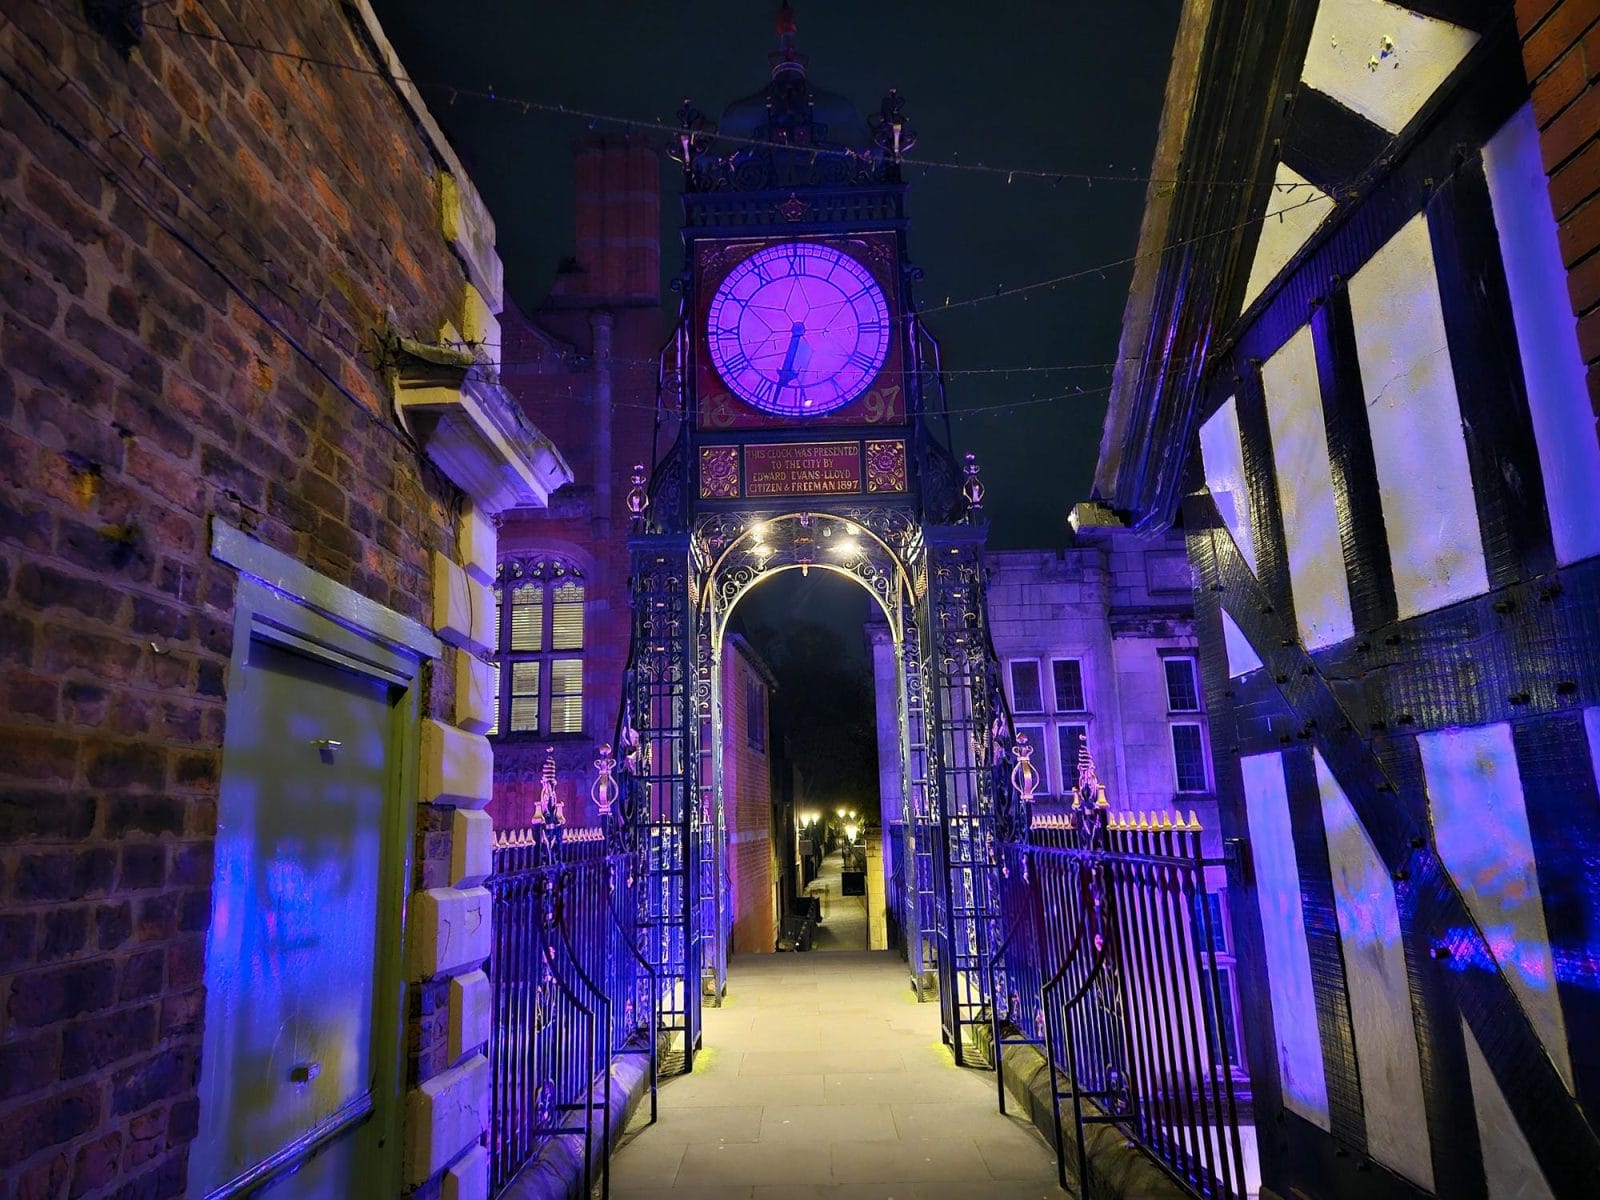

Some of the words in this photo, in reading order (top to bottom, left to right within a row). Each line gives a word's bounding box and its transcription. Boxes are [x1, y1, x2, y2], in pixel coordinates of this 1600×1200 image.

[864, 385, 901, 423] 97
[746, 449, 766, 460] THIS
[767, 448, 793, 459] CLOCK
[794, 447, 813, 458] WAS
[814, 446, 858, 457] PRESENTED
[771, 460, 782, 470] TO
[785, 459, 801, 470] THE
[802, 459, 821, 469] CITY
[823, 458, 834, 468] BY
[752, 472, 786, 482] EDWARD
[791, 469, 851, 480] EVANS-LLOYD
[749, 482, 782, 493] CITIZEN
[784, 483, 791, 492] &
[791, 481, 835, 492] FREEMAN
[837, 480, 859, 491] 1897
